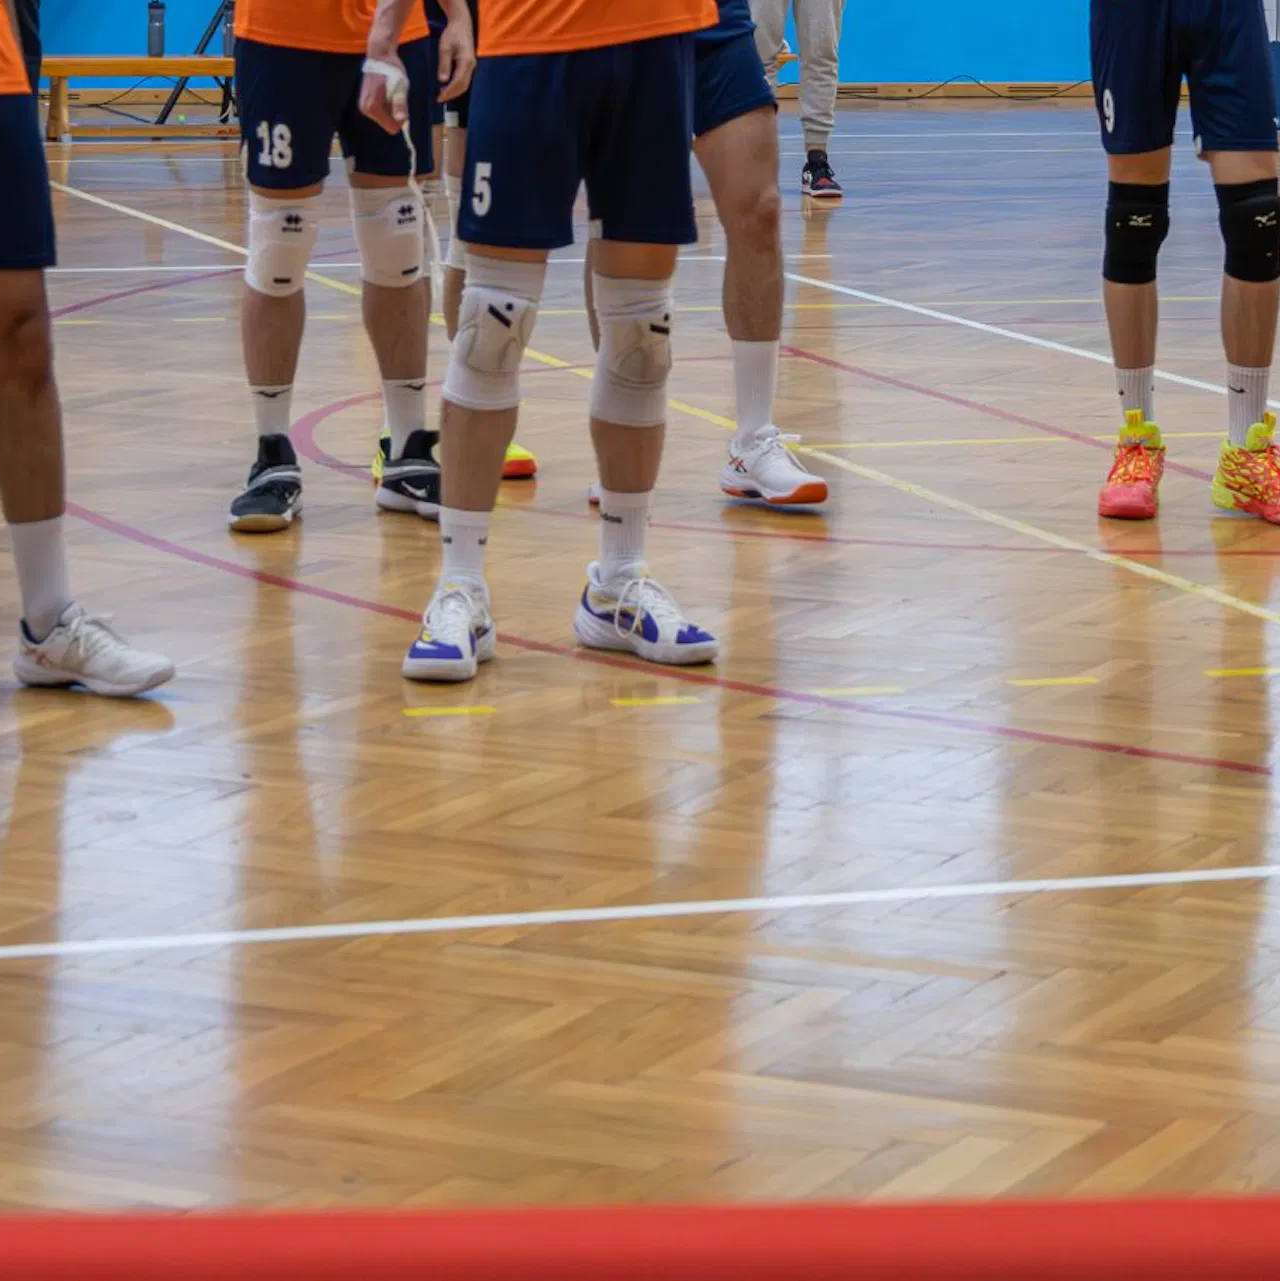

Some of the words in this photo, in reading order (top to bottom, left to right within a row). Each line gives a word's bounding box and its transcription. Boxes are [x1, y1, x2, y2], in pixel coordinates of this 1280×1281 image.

[1103, 88, 1115, 134] 9
[256, 120, 293, 169] 18
[472, 162, 492, 217] 5
